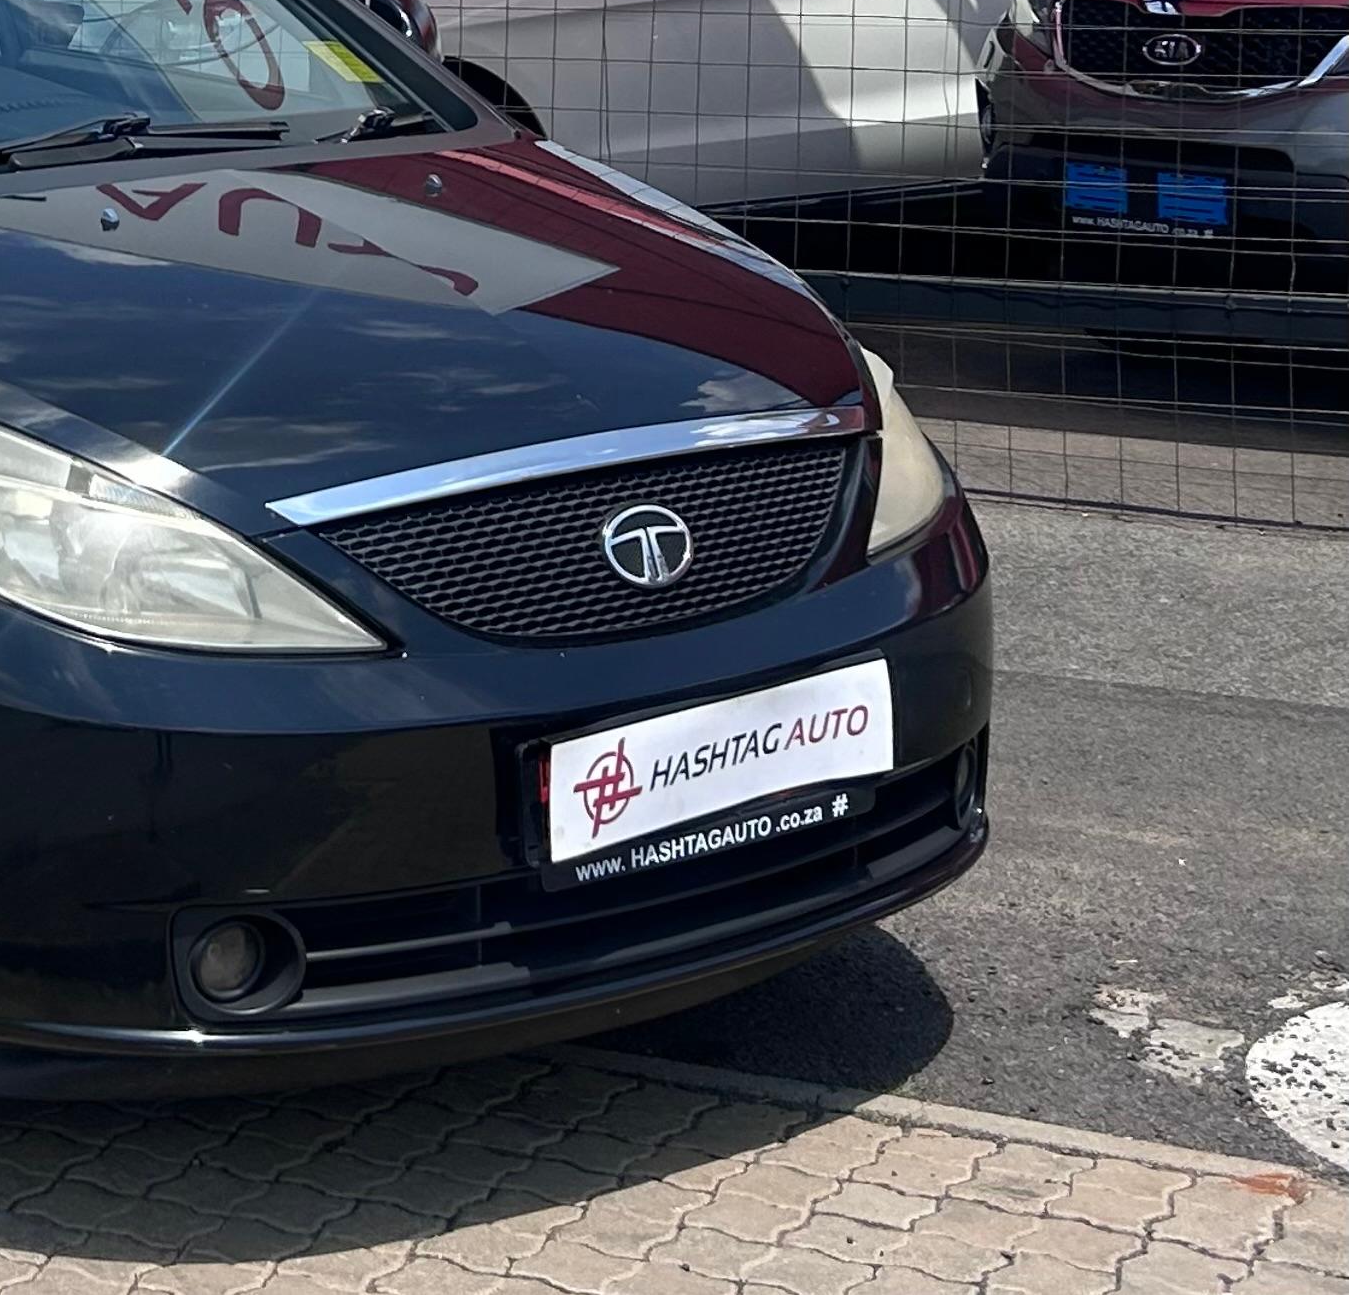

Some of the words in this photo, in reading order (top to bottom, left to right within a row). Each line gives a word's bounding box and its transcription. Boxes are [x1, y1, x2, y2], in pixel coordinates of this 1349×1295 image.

[650, 723, 783, 792] HASHTAG
[784, 705, 869, 751] AUTO
[575, 854, 626, 883] www.
[631, 817, 772, 870] HASHTAGAUTO
